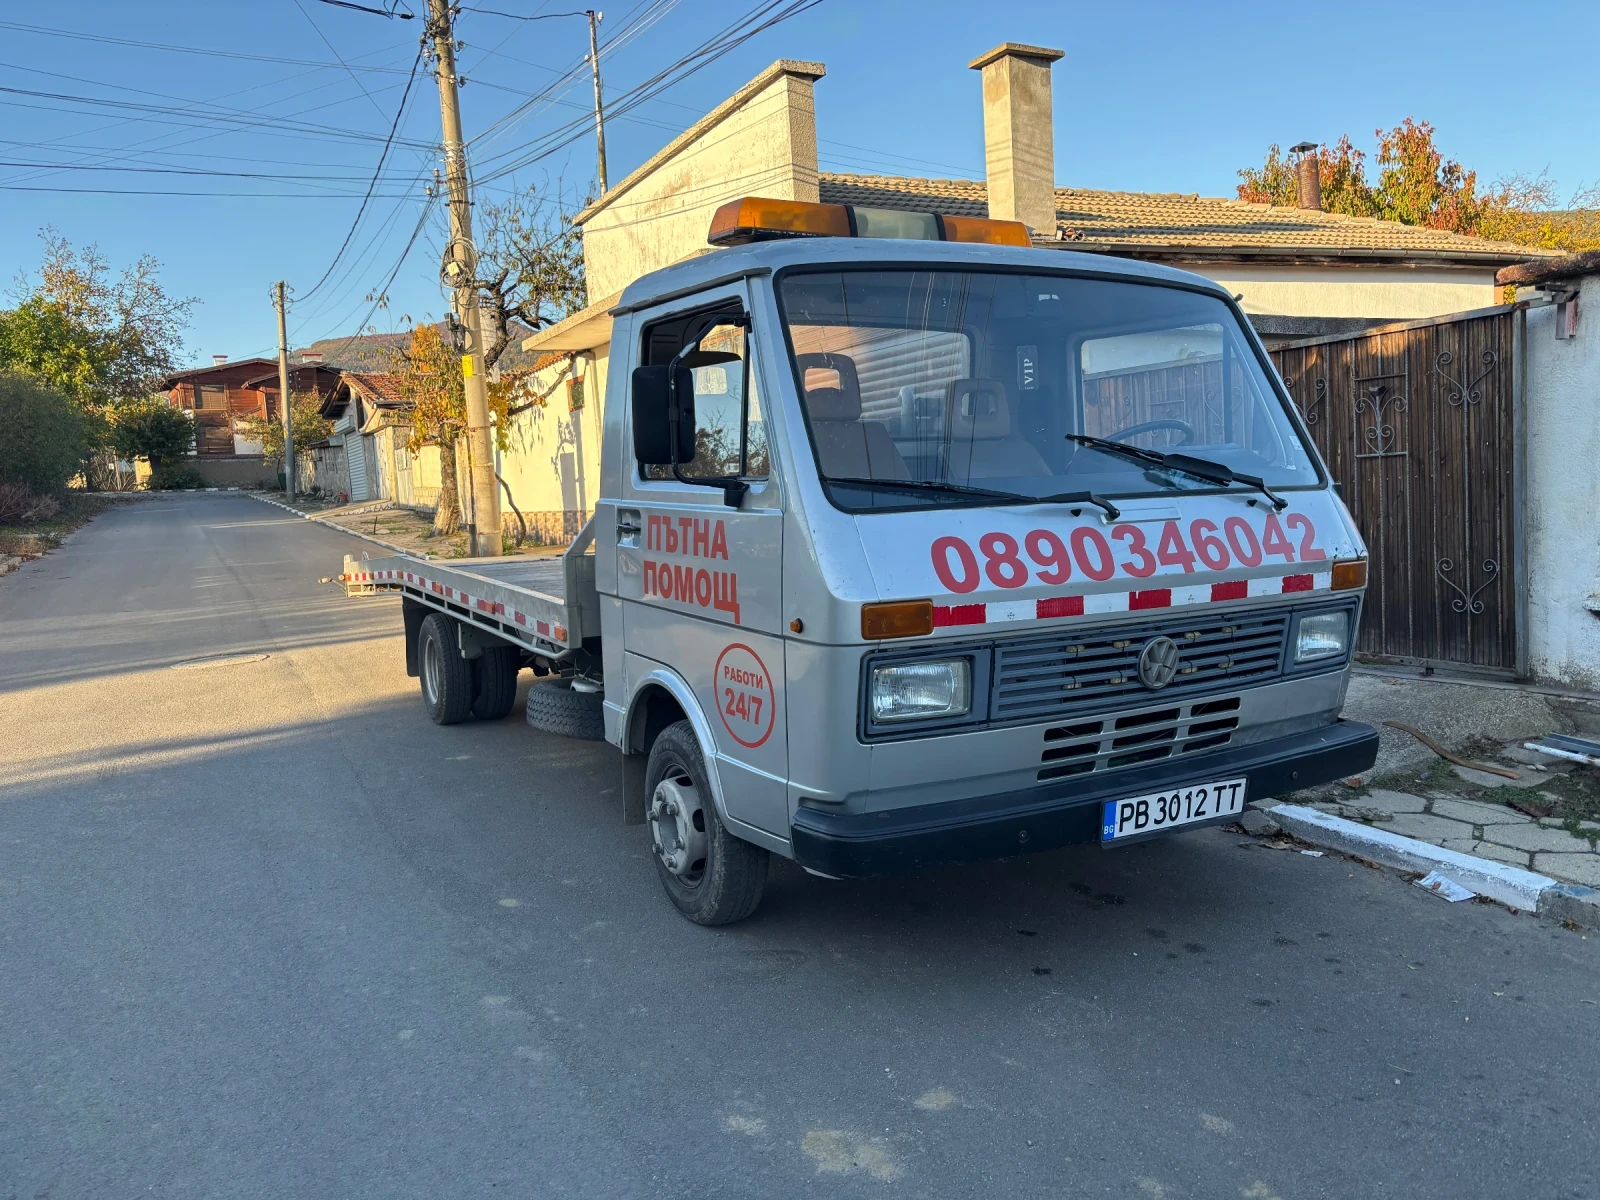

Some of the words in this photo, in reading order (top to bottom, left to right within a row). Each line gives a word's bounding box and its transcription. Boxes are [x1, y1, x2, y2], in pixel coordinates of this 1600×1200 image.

[1024, 358, 1033, 385] VIP
[647, 515, 729, 560] ПЪТНА
[930, 512, 1325, 593] 0890346042
[643, 560, 741, 625] ПОМОЩ
[724, 665, 763, 690] РАБОТИ
[724, 688, 763, 725] 24/7
[1153, 789, 1208, 825] 3012
[1103, 825, 1114, 834] BG
